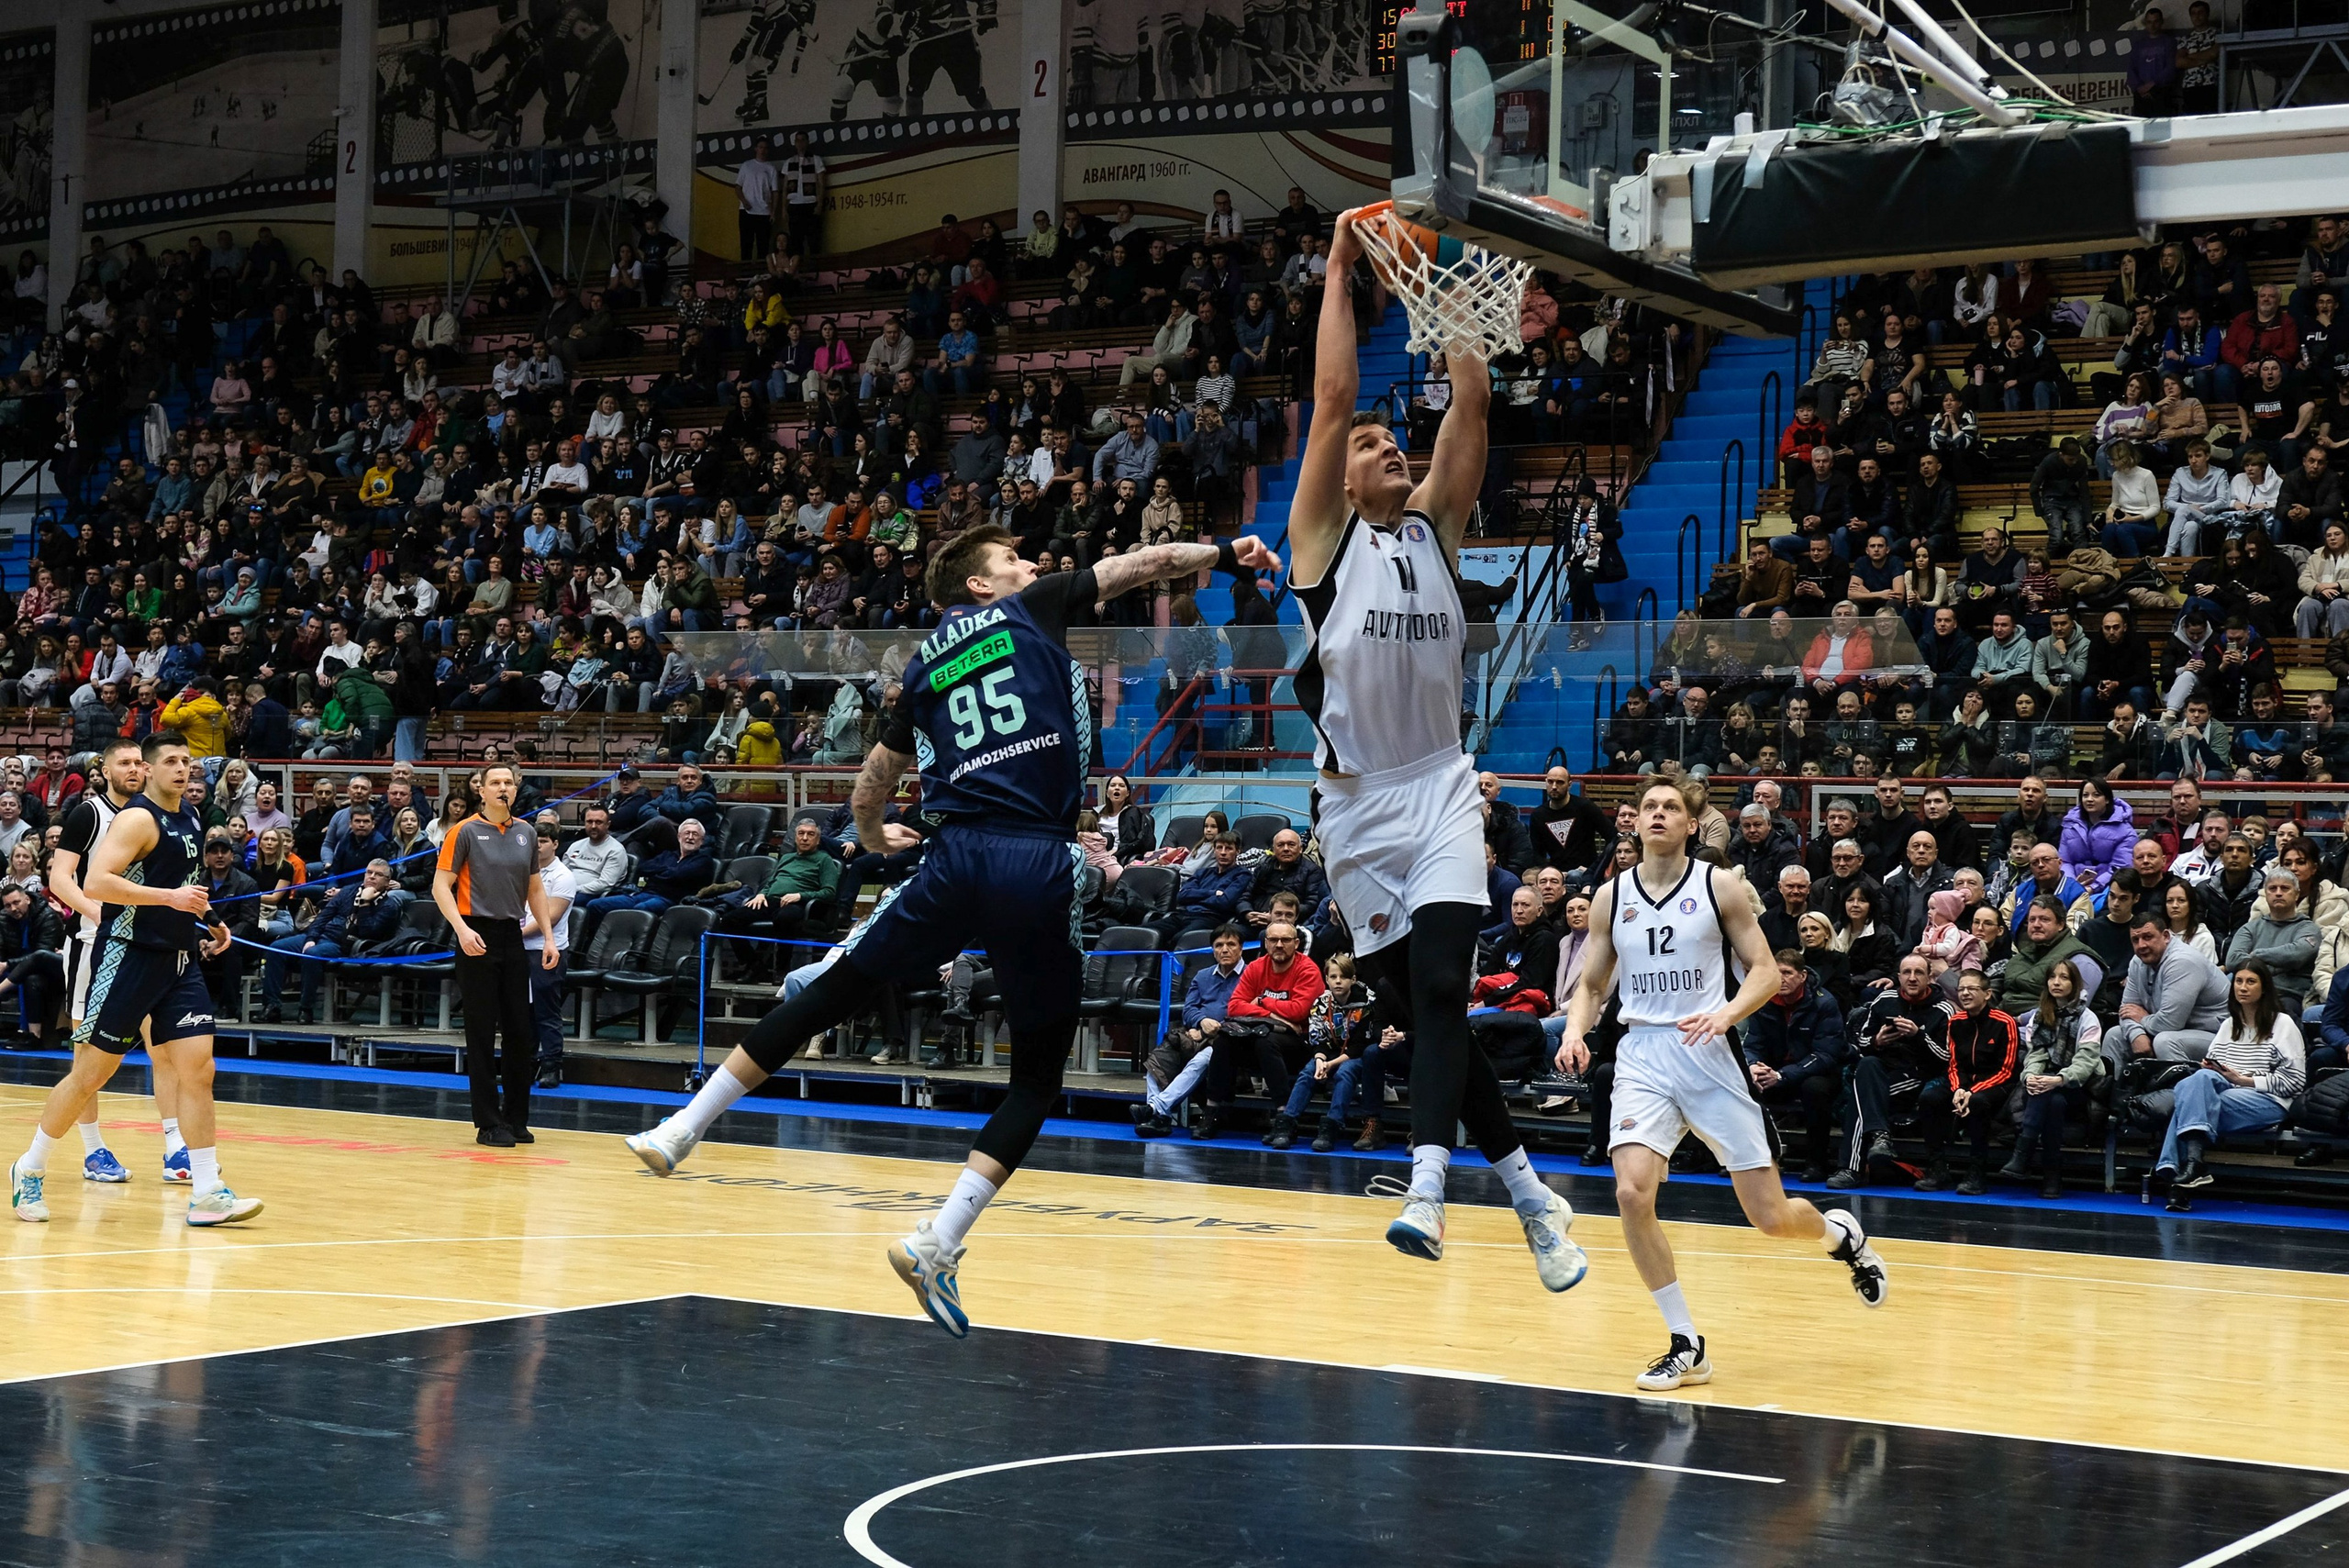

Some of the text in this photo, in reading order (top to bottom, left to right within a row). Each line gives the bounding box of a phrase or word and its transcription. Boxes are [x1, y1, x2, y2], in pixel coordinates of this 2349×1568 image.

[1377, 32, 1396, 50] 30
[1034, 60, 1047, 97] 2
[346, 140, 356, 174] 2
[1083, 161, 1191, 183] АВАНГАРД 1960 гг.
[840, 192, 894, 210] 1948-1954
[920, 607, 1008, 665] ALADKA
[935, 637, 1008, 686] BETERA
[949, 665, 1027, 751] 95
[182, 834, 198, 859] 15
[1645, 925, 1676, 958] 12
[1631, 968, 1706, 995] AVTODOR
